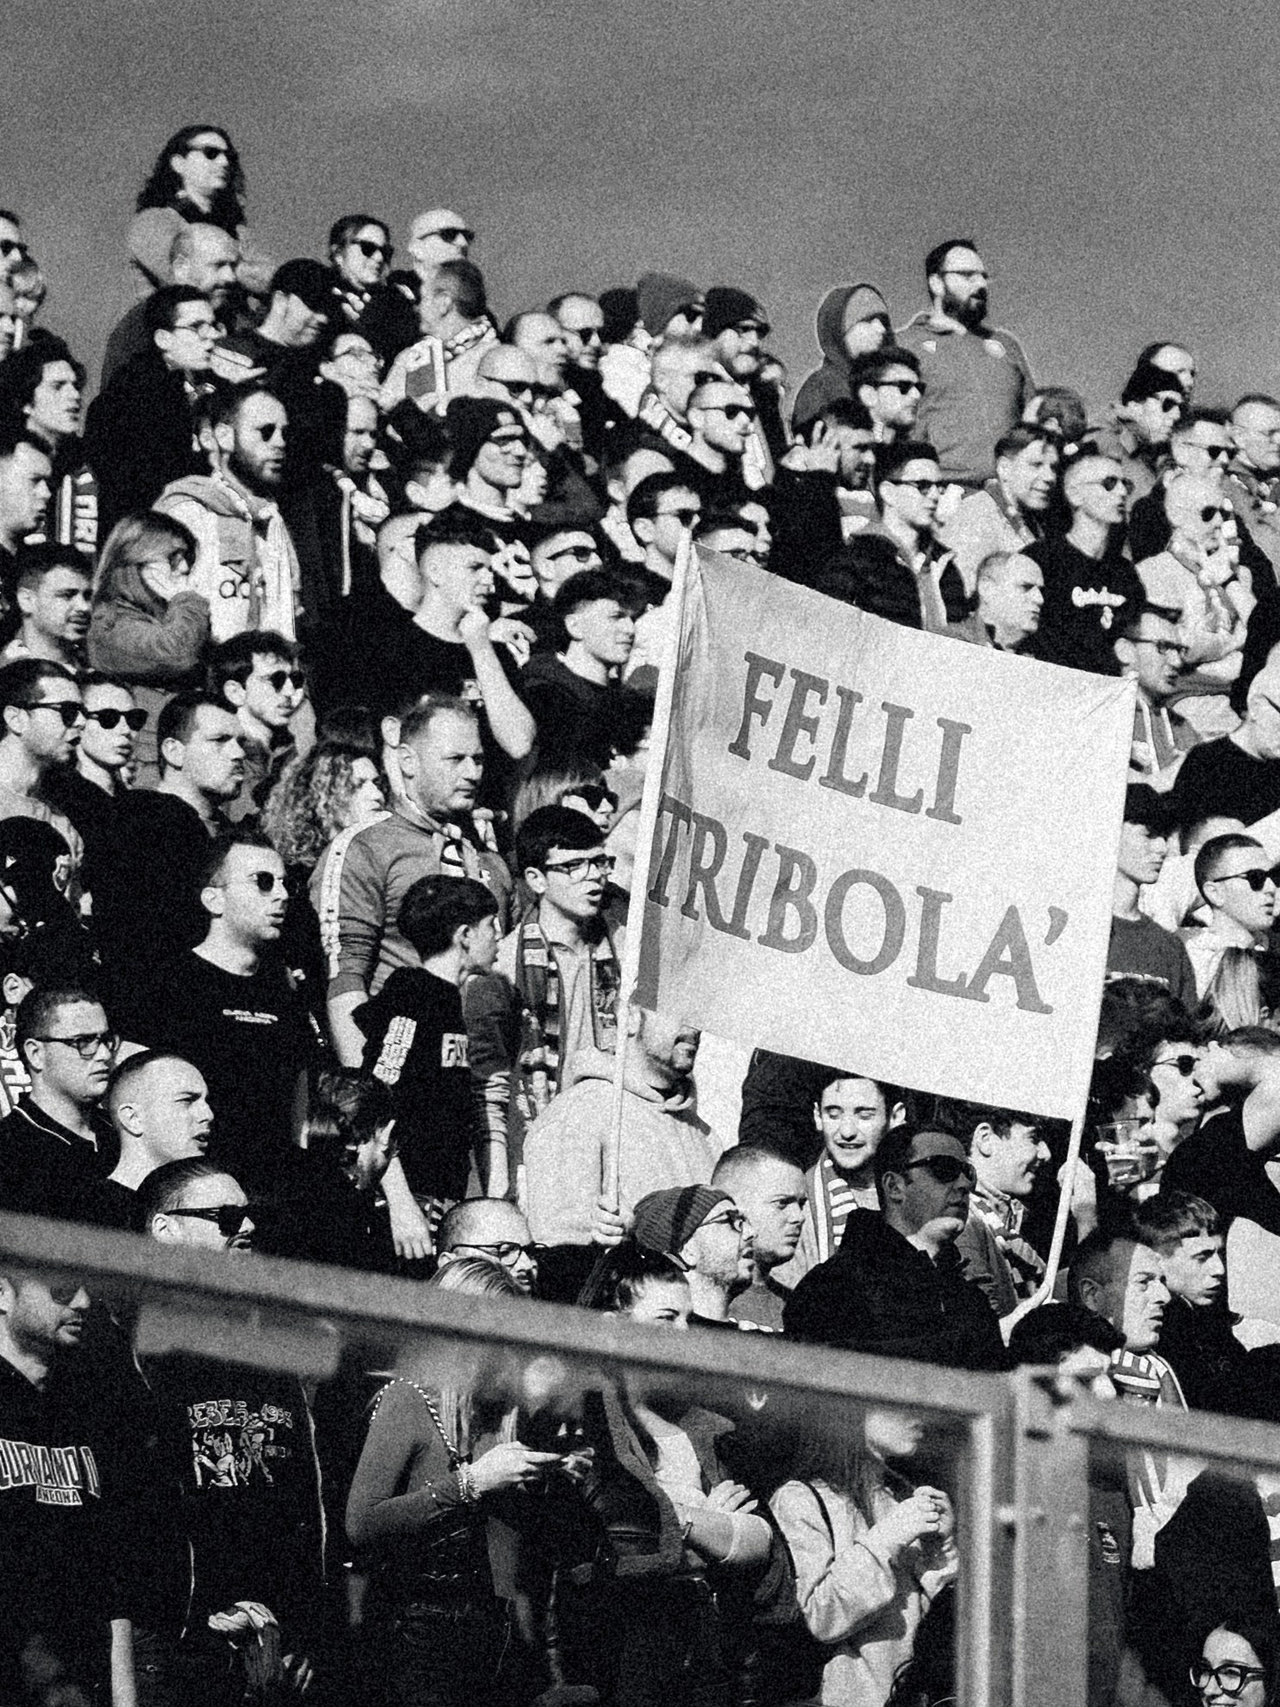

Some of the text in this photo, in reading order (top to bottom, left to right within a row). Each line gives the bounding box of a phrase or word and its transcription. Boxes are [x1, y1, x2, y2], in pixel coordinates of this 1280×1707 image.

[727, 650, 973, 826] FELLI
[647, 793, 1069, 1017] TRIBOLA'
[36, 1484, 83, 1506] ANCONA
